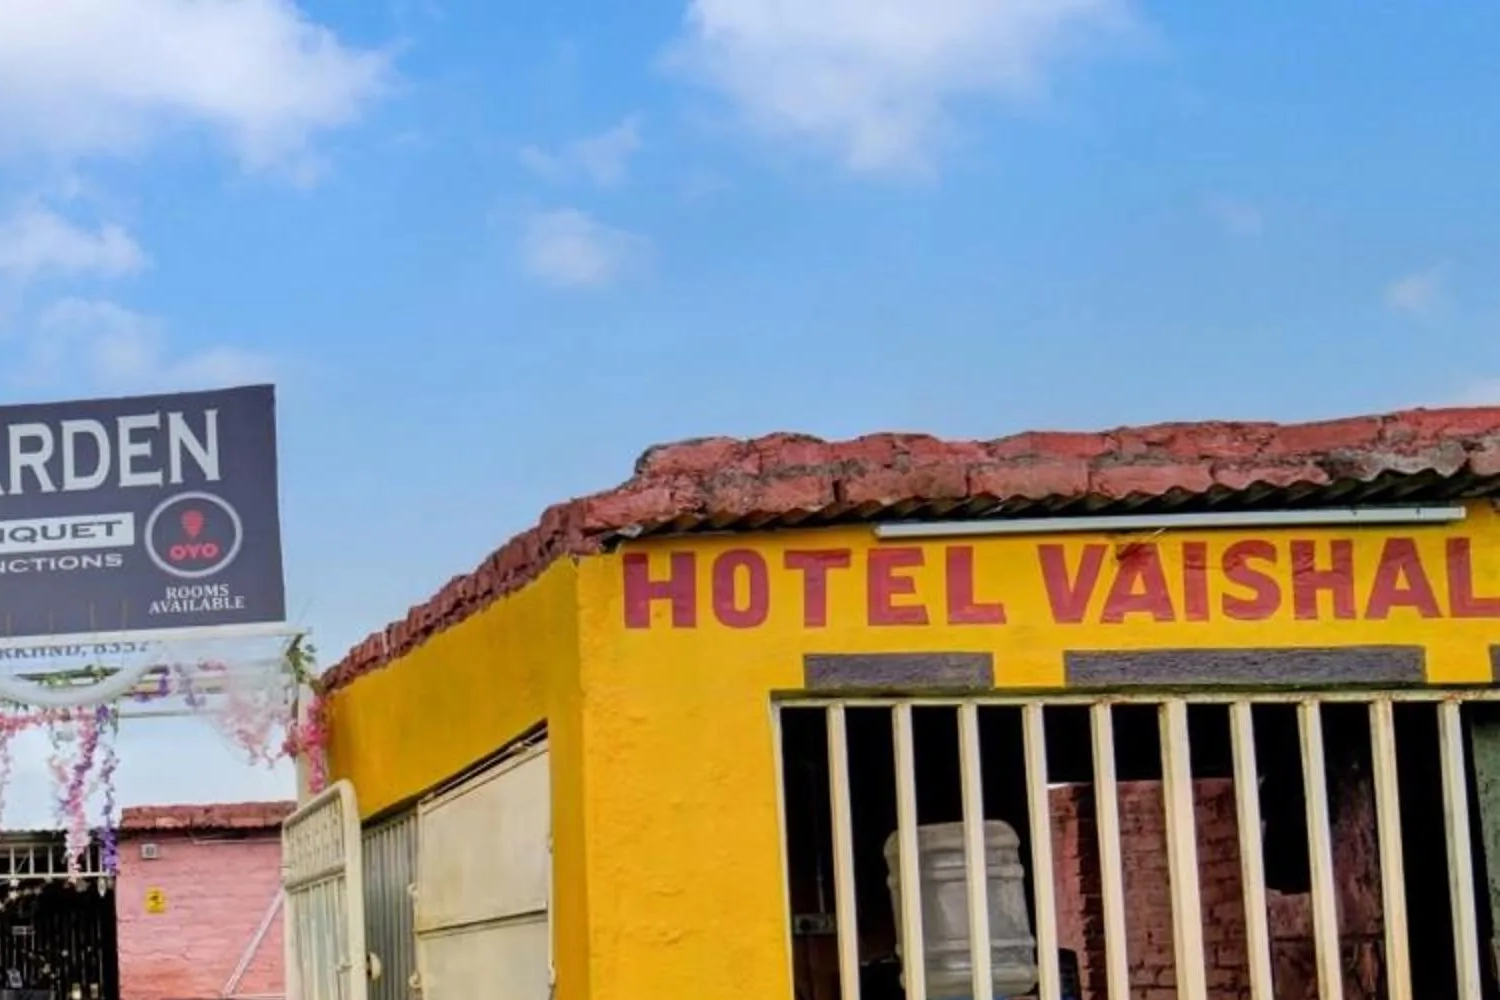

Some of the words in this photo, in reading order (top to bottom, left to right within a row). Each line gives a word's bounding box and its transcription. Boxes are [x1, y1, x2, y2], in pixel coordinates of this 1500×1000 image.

[170, 543, 219, 560] OYO
[165, 583, 229, 600] ROOMS
[622, 546, 1007, 630] HOTEL
[1038, 537, 1500, 624] VAISHAL
[148, 595, 245, 615] AVAILABLE
